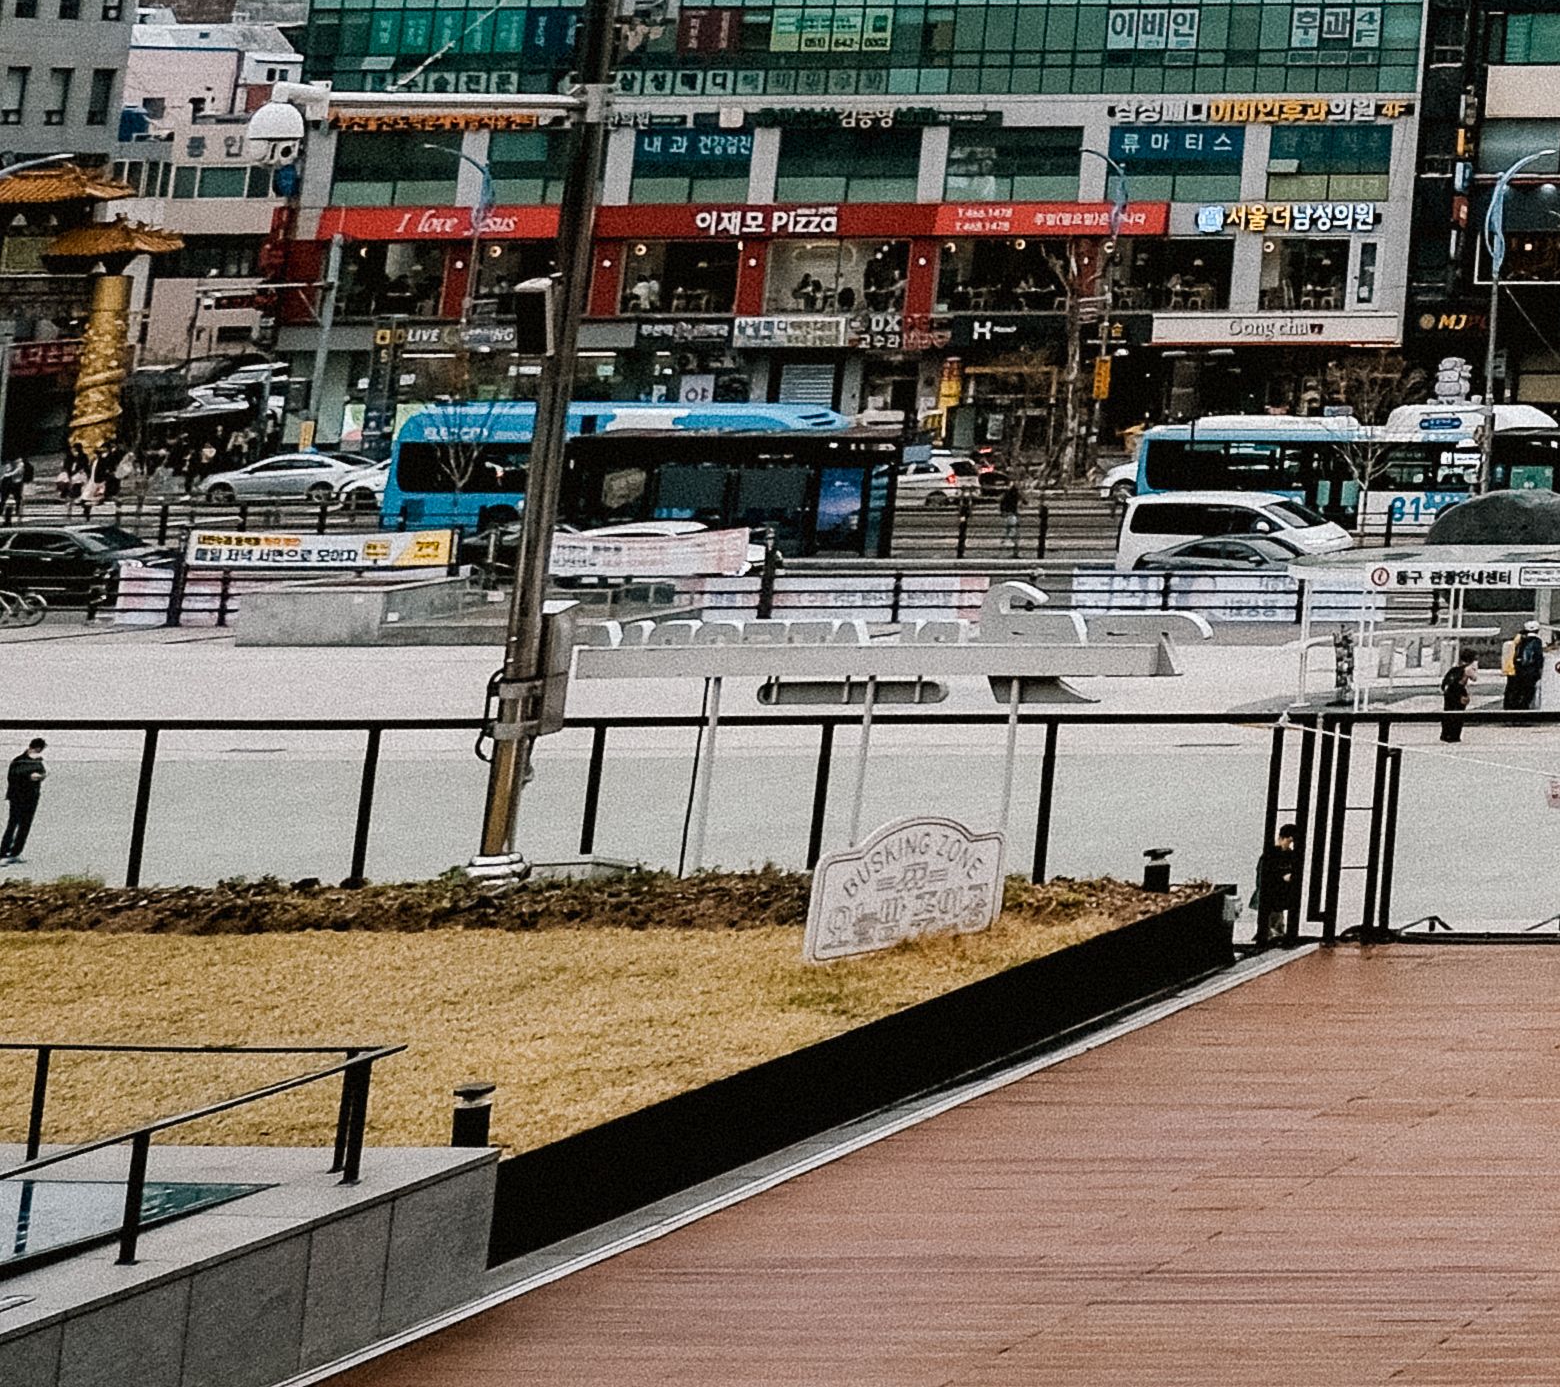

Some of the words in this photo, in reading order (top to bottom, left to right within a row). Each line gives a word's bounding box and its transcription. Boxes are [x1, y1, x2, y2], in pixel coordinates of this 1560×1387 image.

[1111, 10, 1197, 39] 이비인
[1294, 9, 1350, 39] 후과
[643, 135, 689, 156] 내과
[697, 134, 752, 156] 건강검진
[1121, 132, 1233, 153] 류마티스
[415, 211, 459, 234] love
[695, 212, 765, 236] 이재모
[771, 211, 838, 235] Pizza
[1226, 204, 1268, 231] 서울
[1271, 205, 1291, 231] 더
[1292, 203, 1375, 232] 남성의원
[1437, 312, 1468, 330] MJ
[406, 329, 441, 342] LIVE
[1390, 496, 1423, 524] 81
